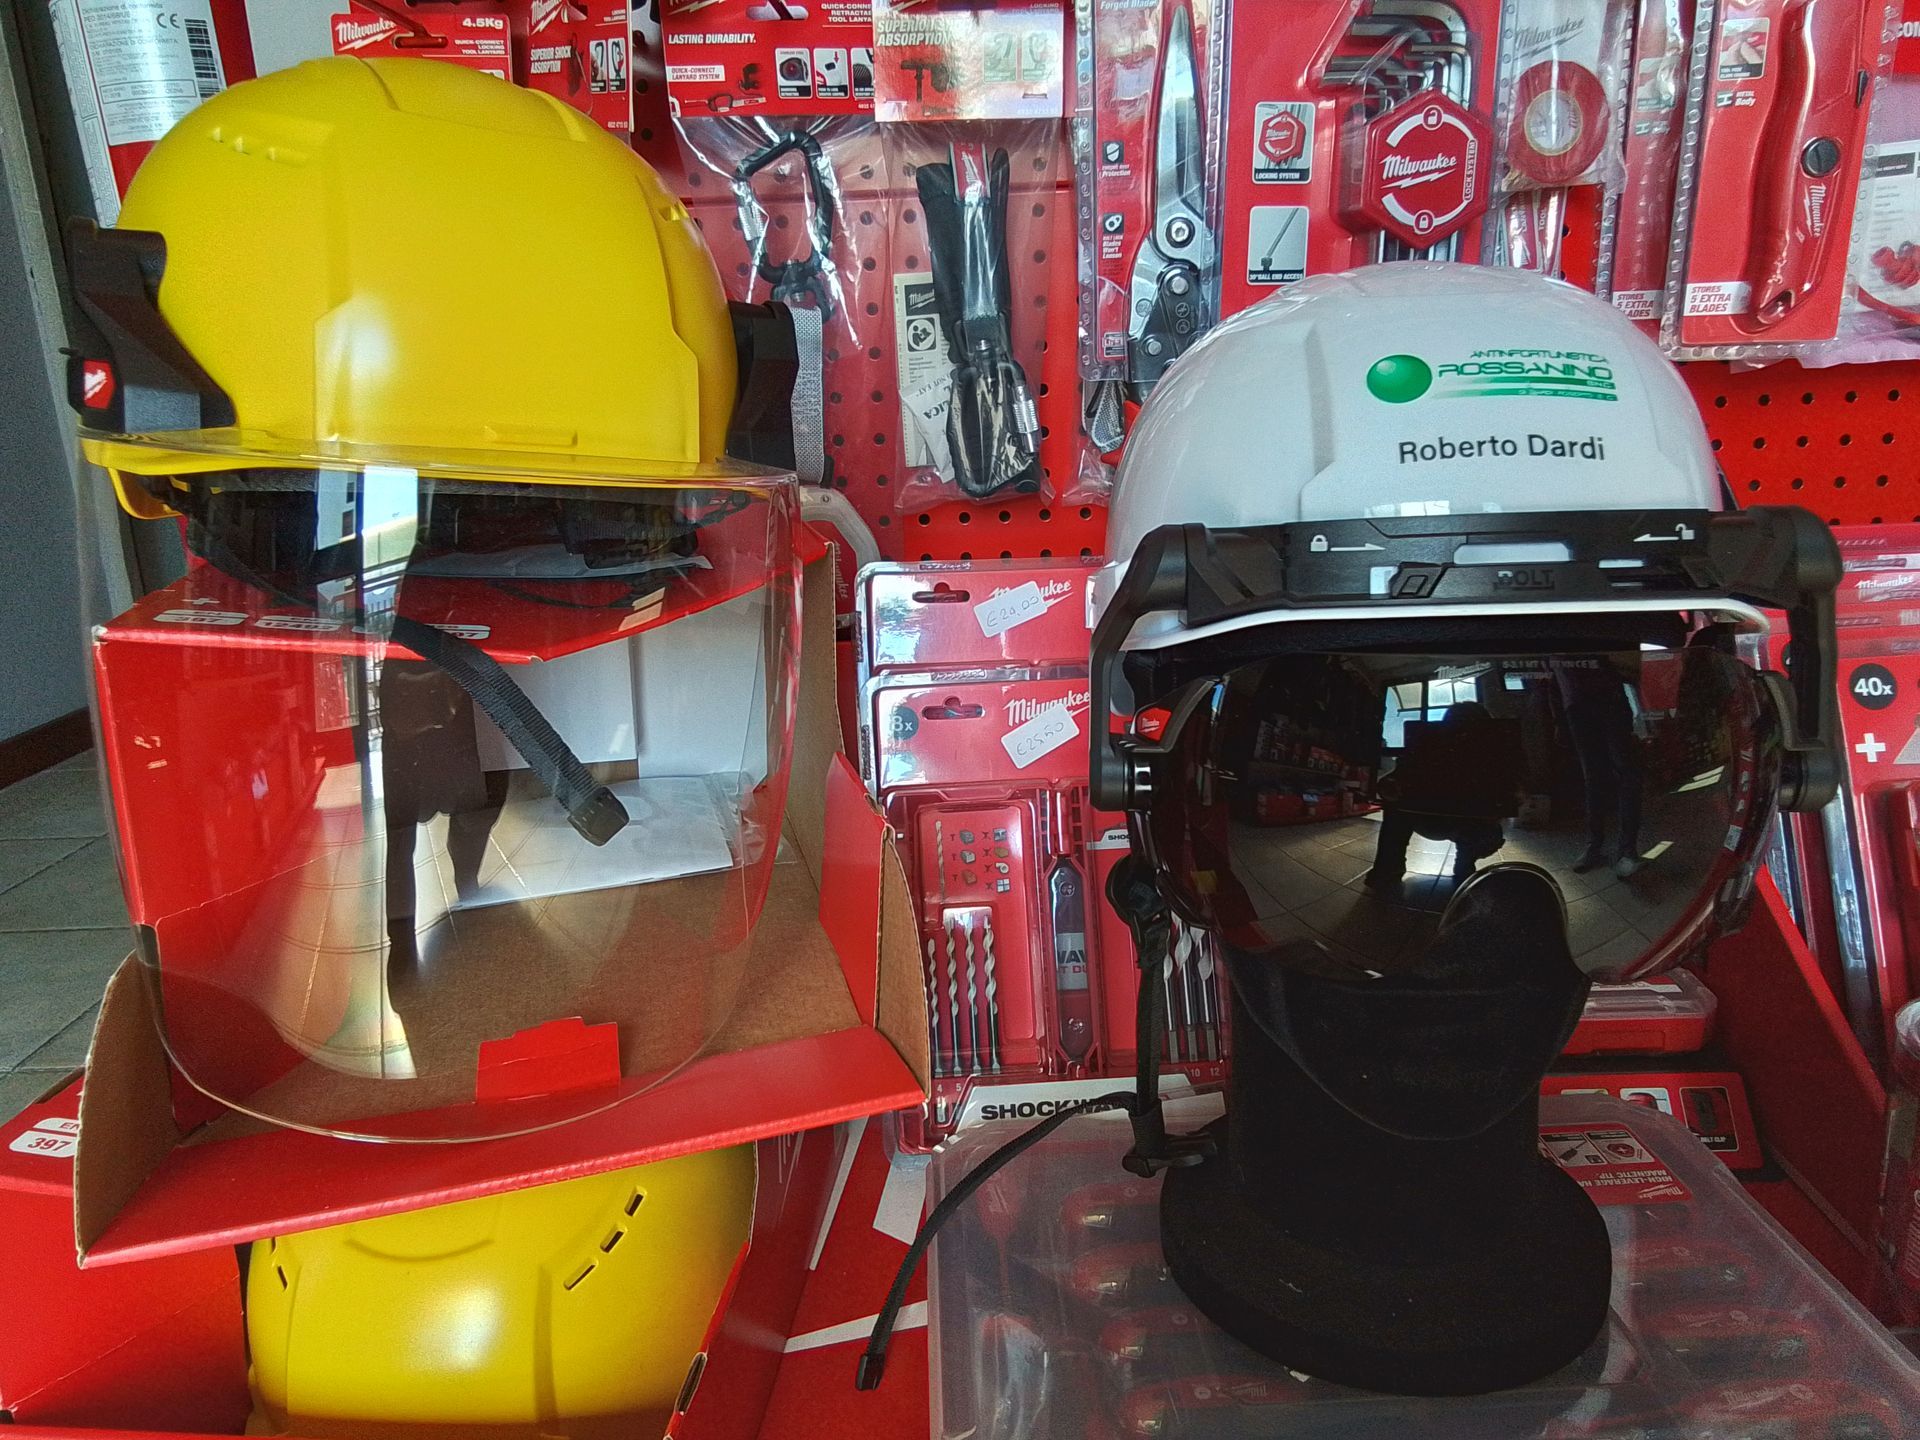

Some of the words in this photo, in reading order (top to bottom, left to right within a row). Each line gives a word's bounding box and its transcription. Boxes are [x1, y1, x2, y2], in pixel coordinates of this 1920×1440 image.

[1100, 1, 1128, 10] Forged
[462, 17, 504, 30] 4.5Kg
[668, 33, 704, 45] LASTING
[705, 33, 757, 44] DURABILITY.
[1467, 140, 1477, 174] SYSTEM
[1379, 152, 1458, 180] Milwaukee
[1255, 172, 1278, 180] LOCKING
[1279, 172, 1300, 180] SYSTEM
[1464, 174, 1474, 200] LOCK
[1809, 183, 1827, 237] Milwaukee
[1691, 285, 1722, 293] STORES
[1616, 293, 1644, 301] STORES
[1691, 295, 1698, 303] 5
[1700, 294, 1731, 302] EXTRA
[1625, 301, 1654, 309] EXTRA
[1690, 304, 1728, 312] BLADES
[1623, 308, 1651, 317] LADES
[1398, 435, 1518, 464] Roberto
[1527, 433, 1605, 460] Dardi
[1497, 568, 1553, 586] BOLT
[1855, 574, 1915, 589] Milwaukee
[1854, 677, 1894, 696] 40x
[891, 716, 913, 732] 8x
[1191, 1069, 1200, 1078] 10
[1210, 1067, 1220, 1076] 12
[937, 1084, 943, 1092] 4
[956, 1083, 962, 1092] 5
[28, 1137, 72, 1151] 397
